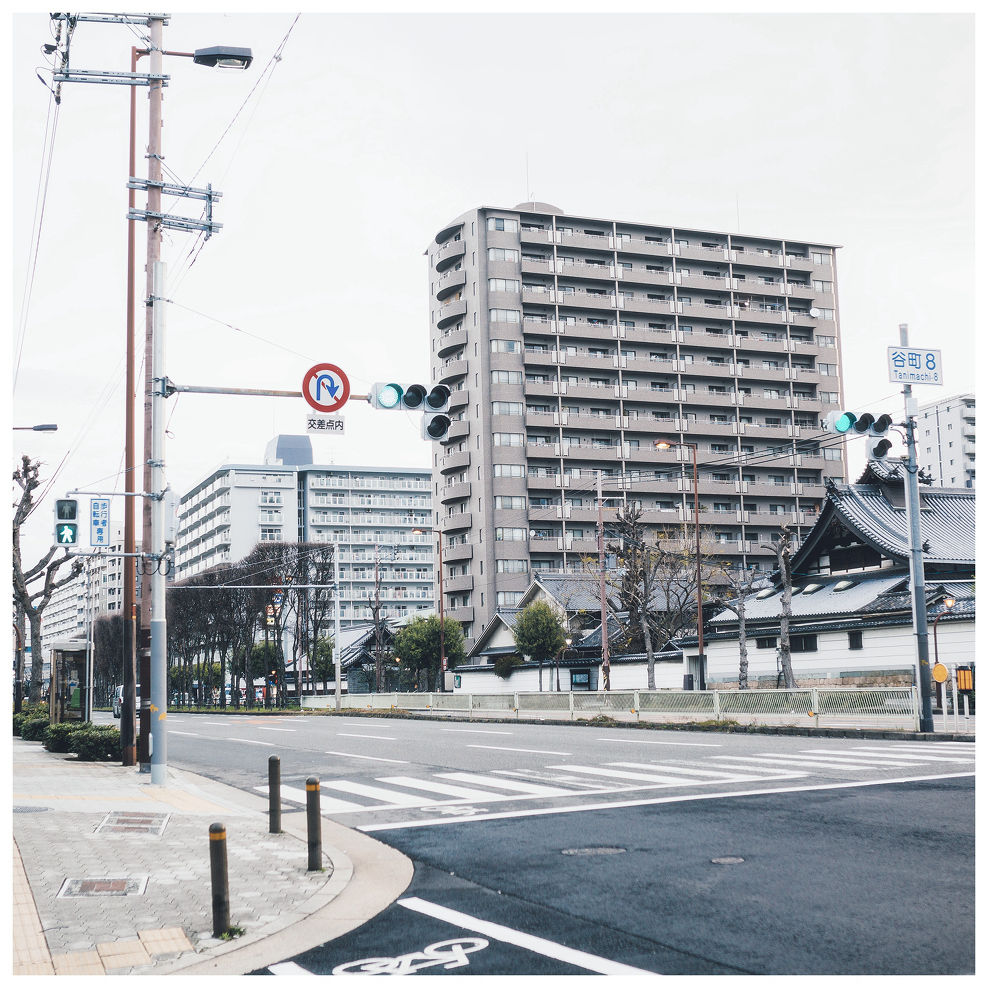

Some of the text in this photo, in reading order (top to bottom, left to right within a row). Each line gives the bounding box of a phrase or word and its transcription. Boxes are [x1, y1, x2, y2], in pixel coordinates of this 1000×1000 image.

[892, 351, 936, 370] 谷町8
[307, 419, 343, 430] 交差点内
